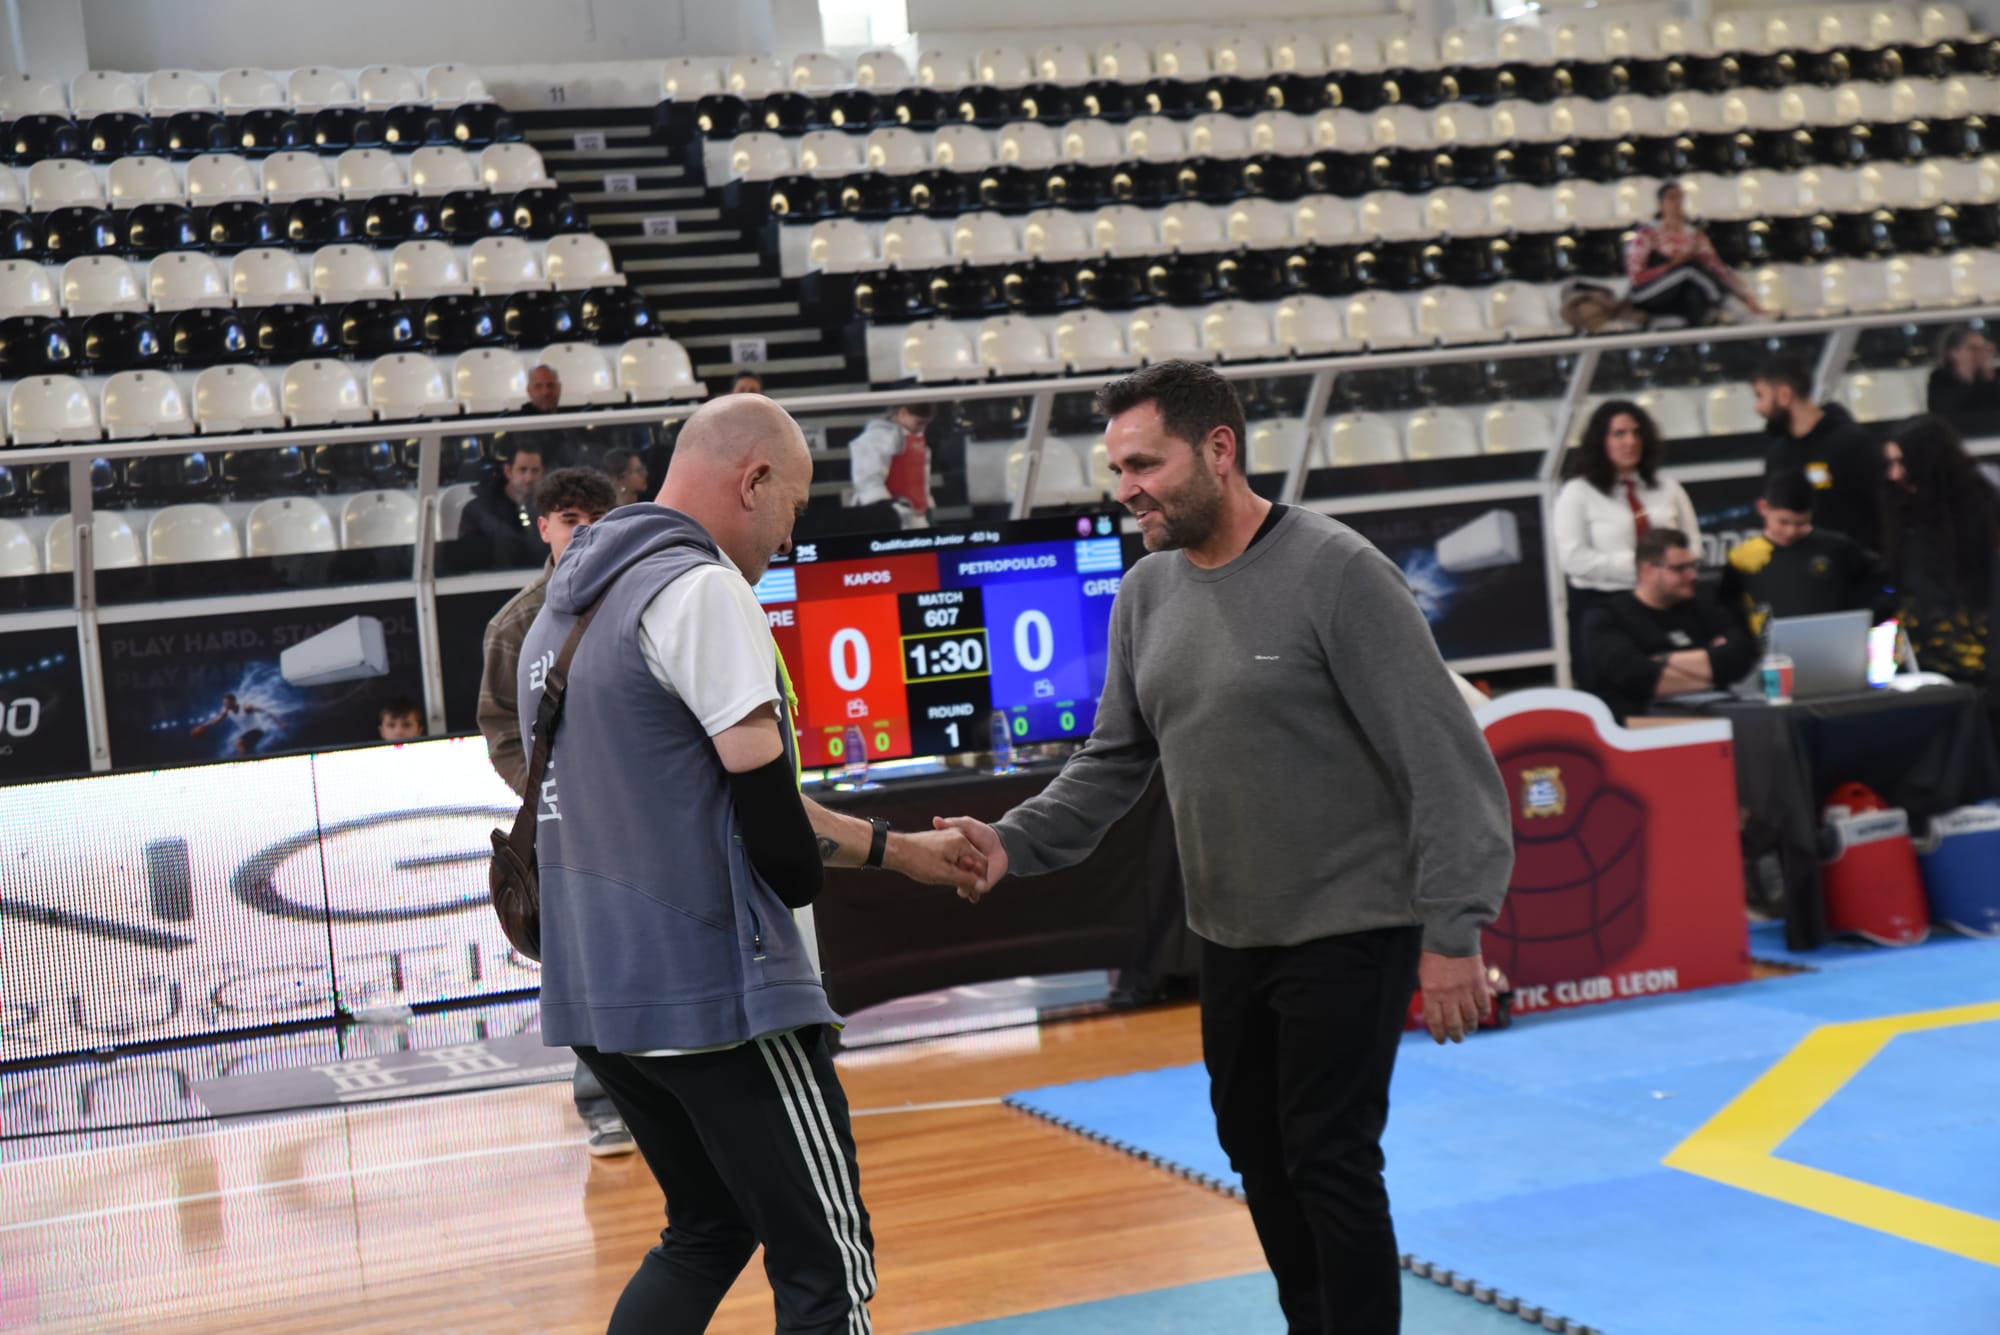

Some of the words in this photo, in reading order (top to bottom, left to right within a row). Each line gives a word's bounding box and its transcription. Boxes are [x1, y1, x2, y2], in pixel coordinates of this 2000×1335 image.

[549, 86, 566, 103] 11
[870, 537, 933, 552] Qualification
[934, 534, 965, 546] Junior
[958, 554, 1057, 576] PETROPOULOS
[843, 570, 892, 587] KAPOS
[1083, 578, 1120, 597] GRE
[918, 591, 964, 607] MATCH
[768, 609, 795, 628] RE
[924, 607, 959, 627] 607
[111, 634, 176, 659] PLAY
[1013, 610, 1054, 672] 0
[829, 628, 872, 692] 0
[910, 637, 984, 676] 1:30
[928, 702, 974, 720] ROUND
[1013, 716, 1028, 737] 0
[1060, 711, 1075, 732] 0
[828, 737, 844, 757] 0
[874, 732, 890, 752] 0
[945, 722, 960, 749] 1
[1514, 984, 1549, 1010] TIC
[1554, 975, 1614, 1004] CLUB
[1618, 967, 1679, 996] LEON
